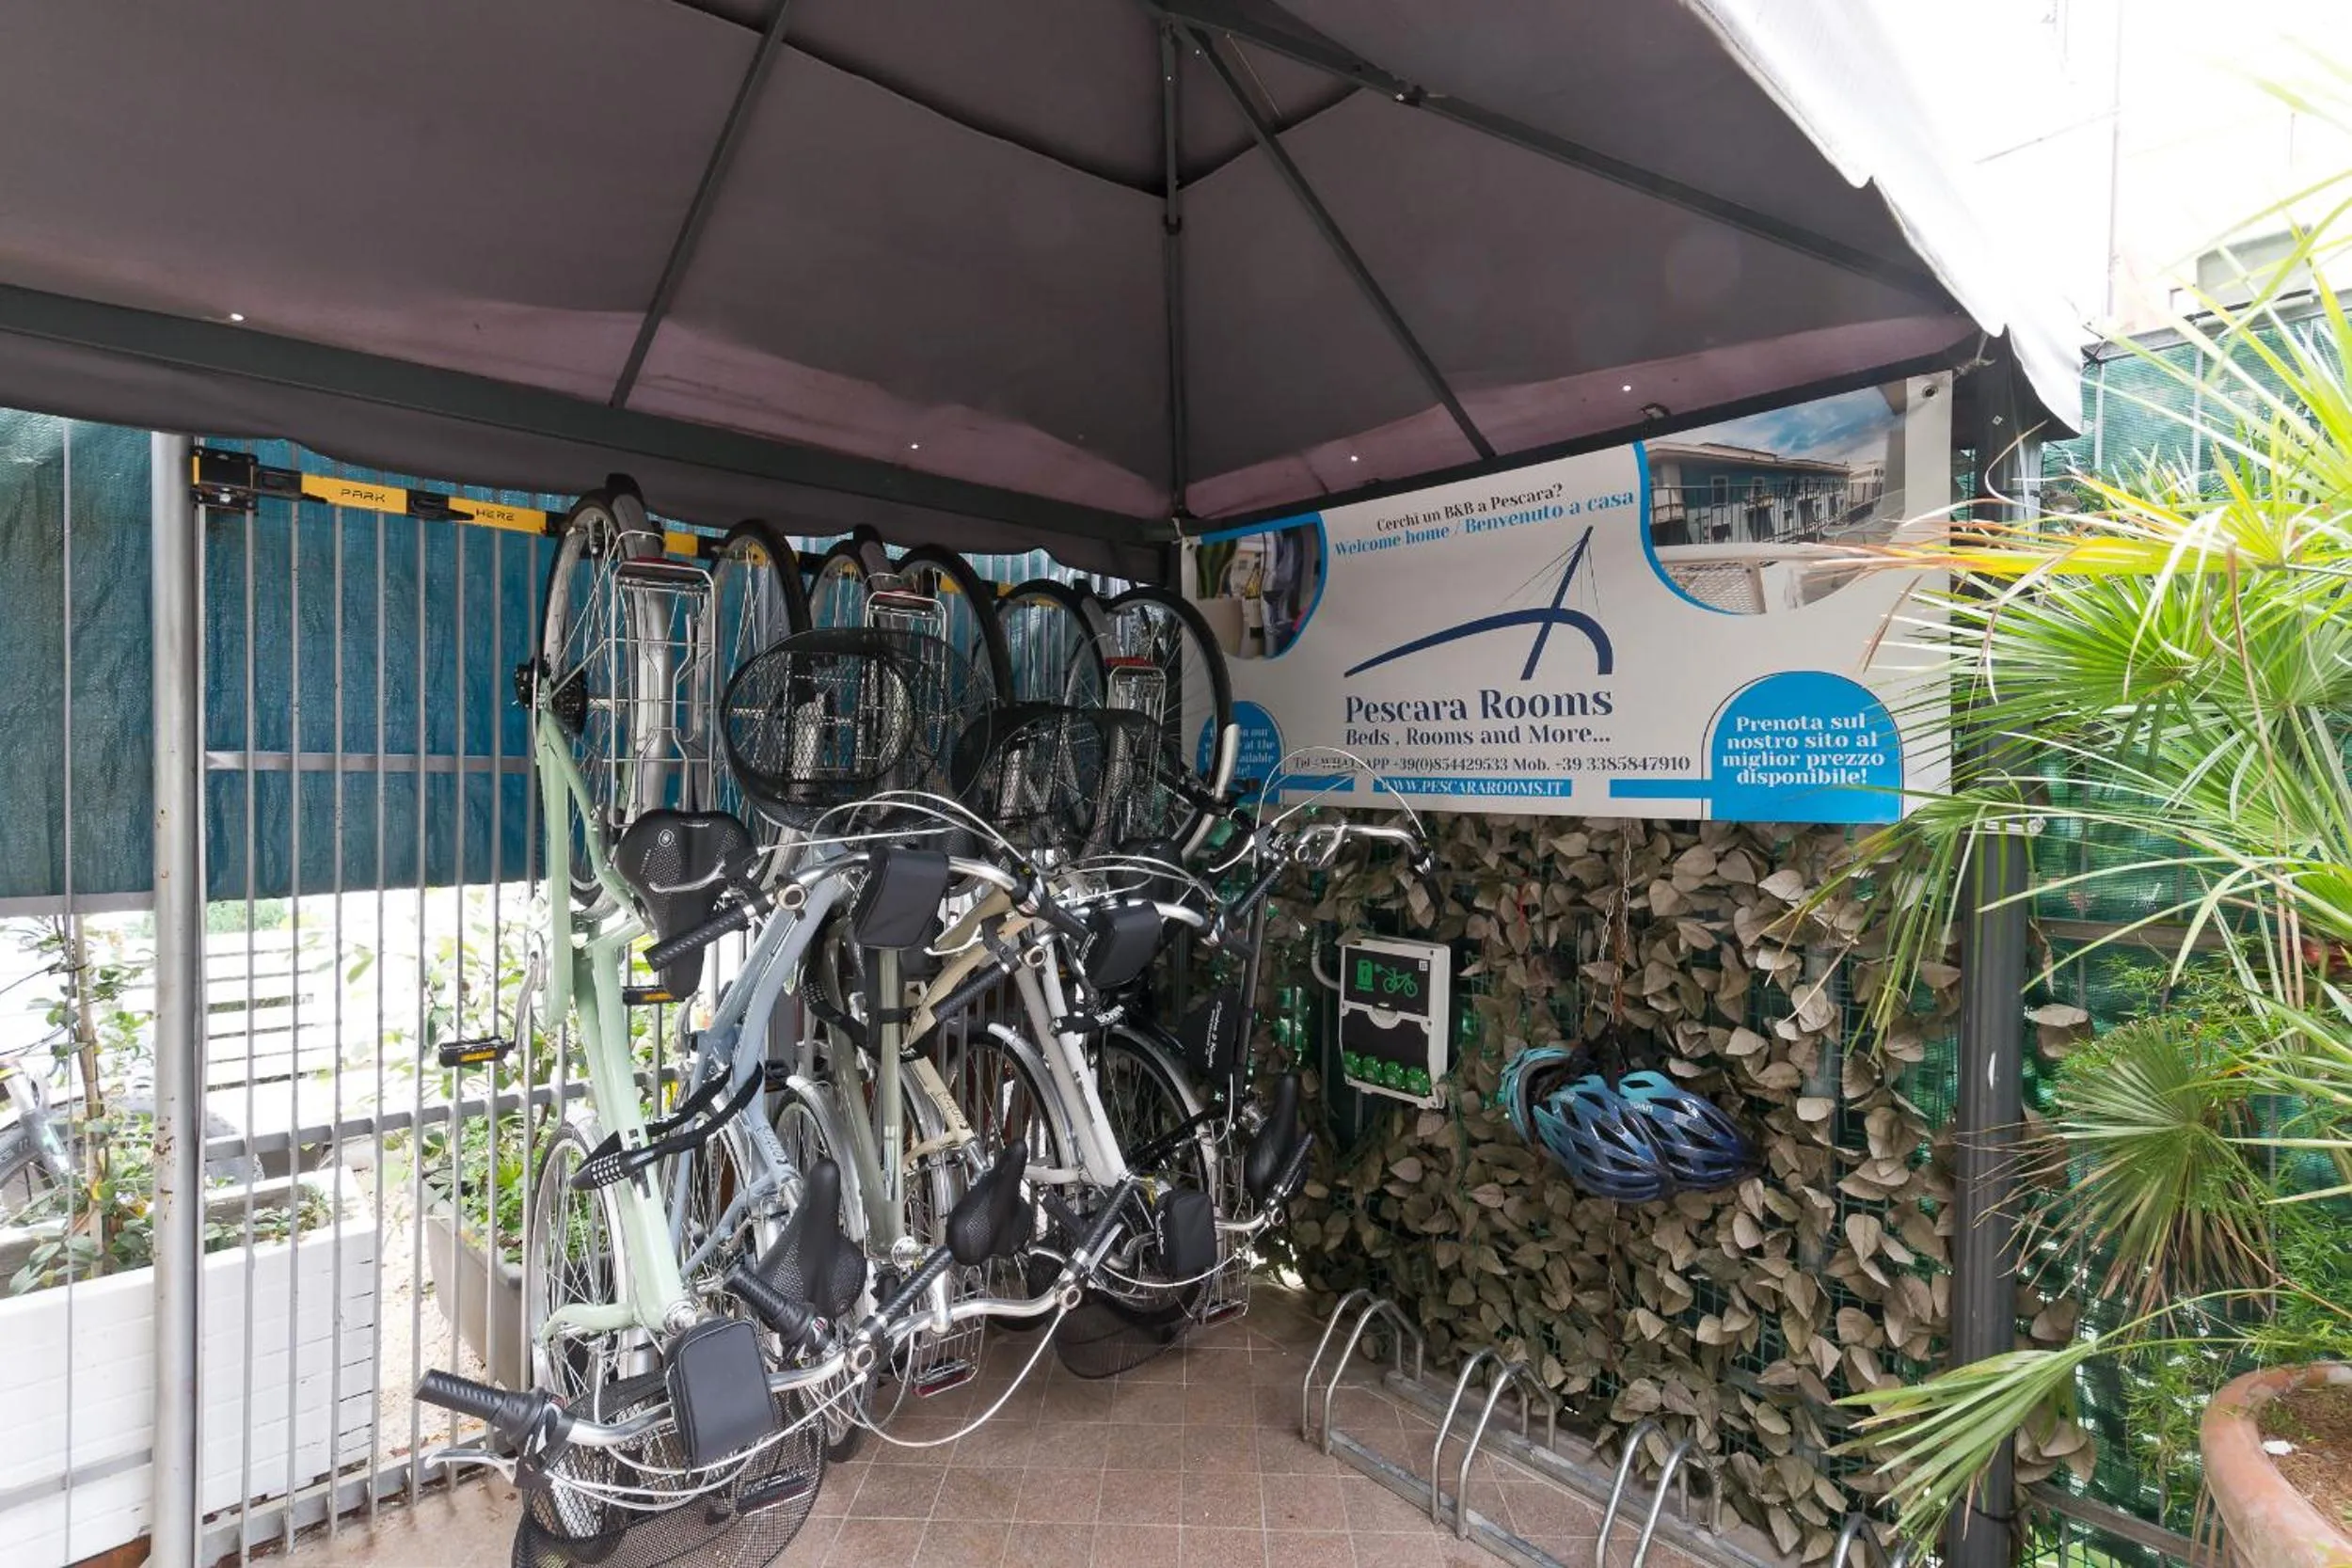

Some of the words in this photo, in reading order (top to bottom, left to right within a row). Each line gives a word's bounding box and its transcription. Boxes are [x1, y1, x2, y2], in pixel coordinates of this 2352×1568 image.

[341, 488, 386, 503] PARK
[475, 509, 515, 521] HERE
[1376, 514, 1420, 532] Cerchi
[1422, 511, 1440, 524] un
[1444, 501, 1474, 518] B&B
[1478, 502, 1487, 513] a
[1490, 482, 1564, 510] Pescara?
[1334, 535, 1402, 556] Welcome
[1406, 525, 1450, 545] home
[1465, 504, 1565, 534] Benvenuto
[1568, 500, 1581, 515] a
[1587, 491, 1634, 513] casa
[1344, 695, 1468, 723] Pescara
[1478, 689, 1613, 719] Rooms
[1737, 715, 1823, 732] Prenota
[1831, 712, 1866, 729] sul
[1345, 727, 1390, 746] Beds
[1406, 727, 1474, 746] Rooms
[1481, 724, 1521, 745] and
[1528, 724, 1611, 745] More...
[1727, 735, 1799, 750] nostro
[1804, 732, 1849, 749] sito
[1856, 730, 1878, 747] al
[1513, 757, 1550, 771] Mob.
[1586, 756, 1692, 771] 3385847910
[1723, 751, 1801, 768] miglior
[1806, 752, 1885, 770] prezzo
[1737, 767, 1867, 787] disponibile!
[1380, 779, 1564, 796] WWW.PESCARAROOMS.IT
